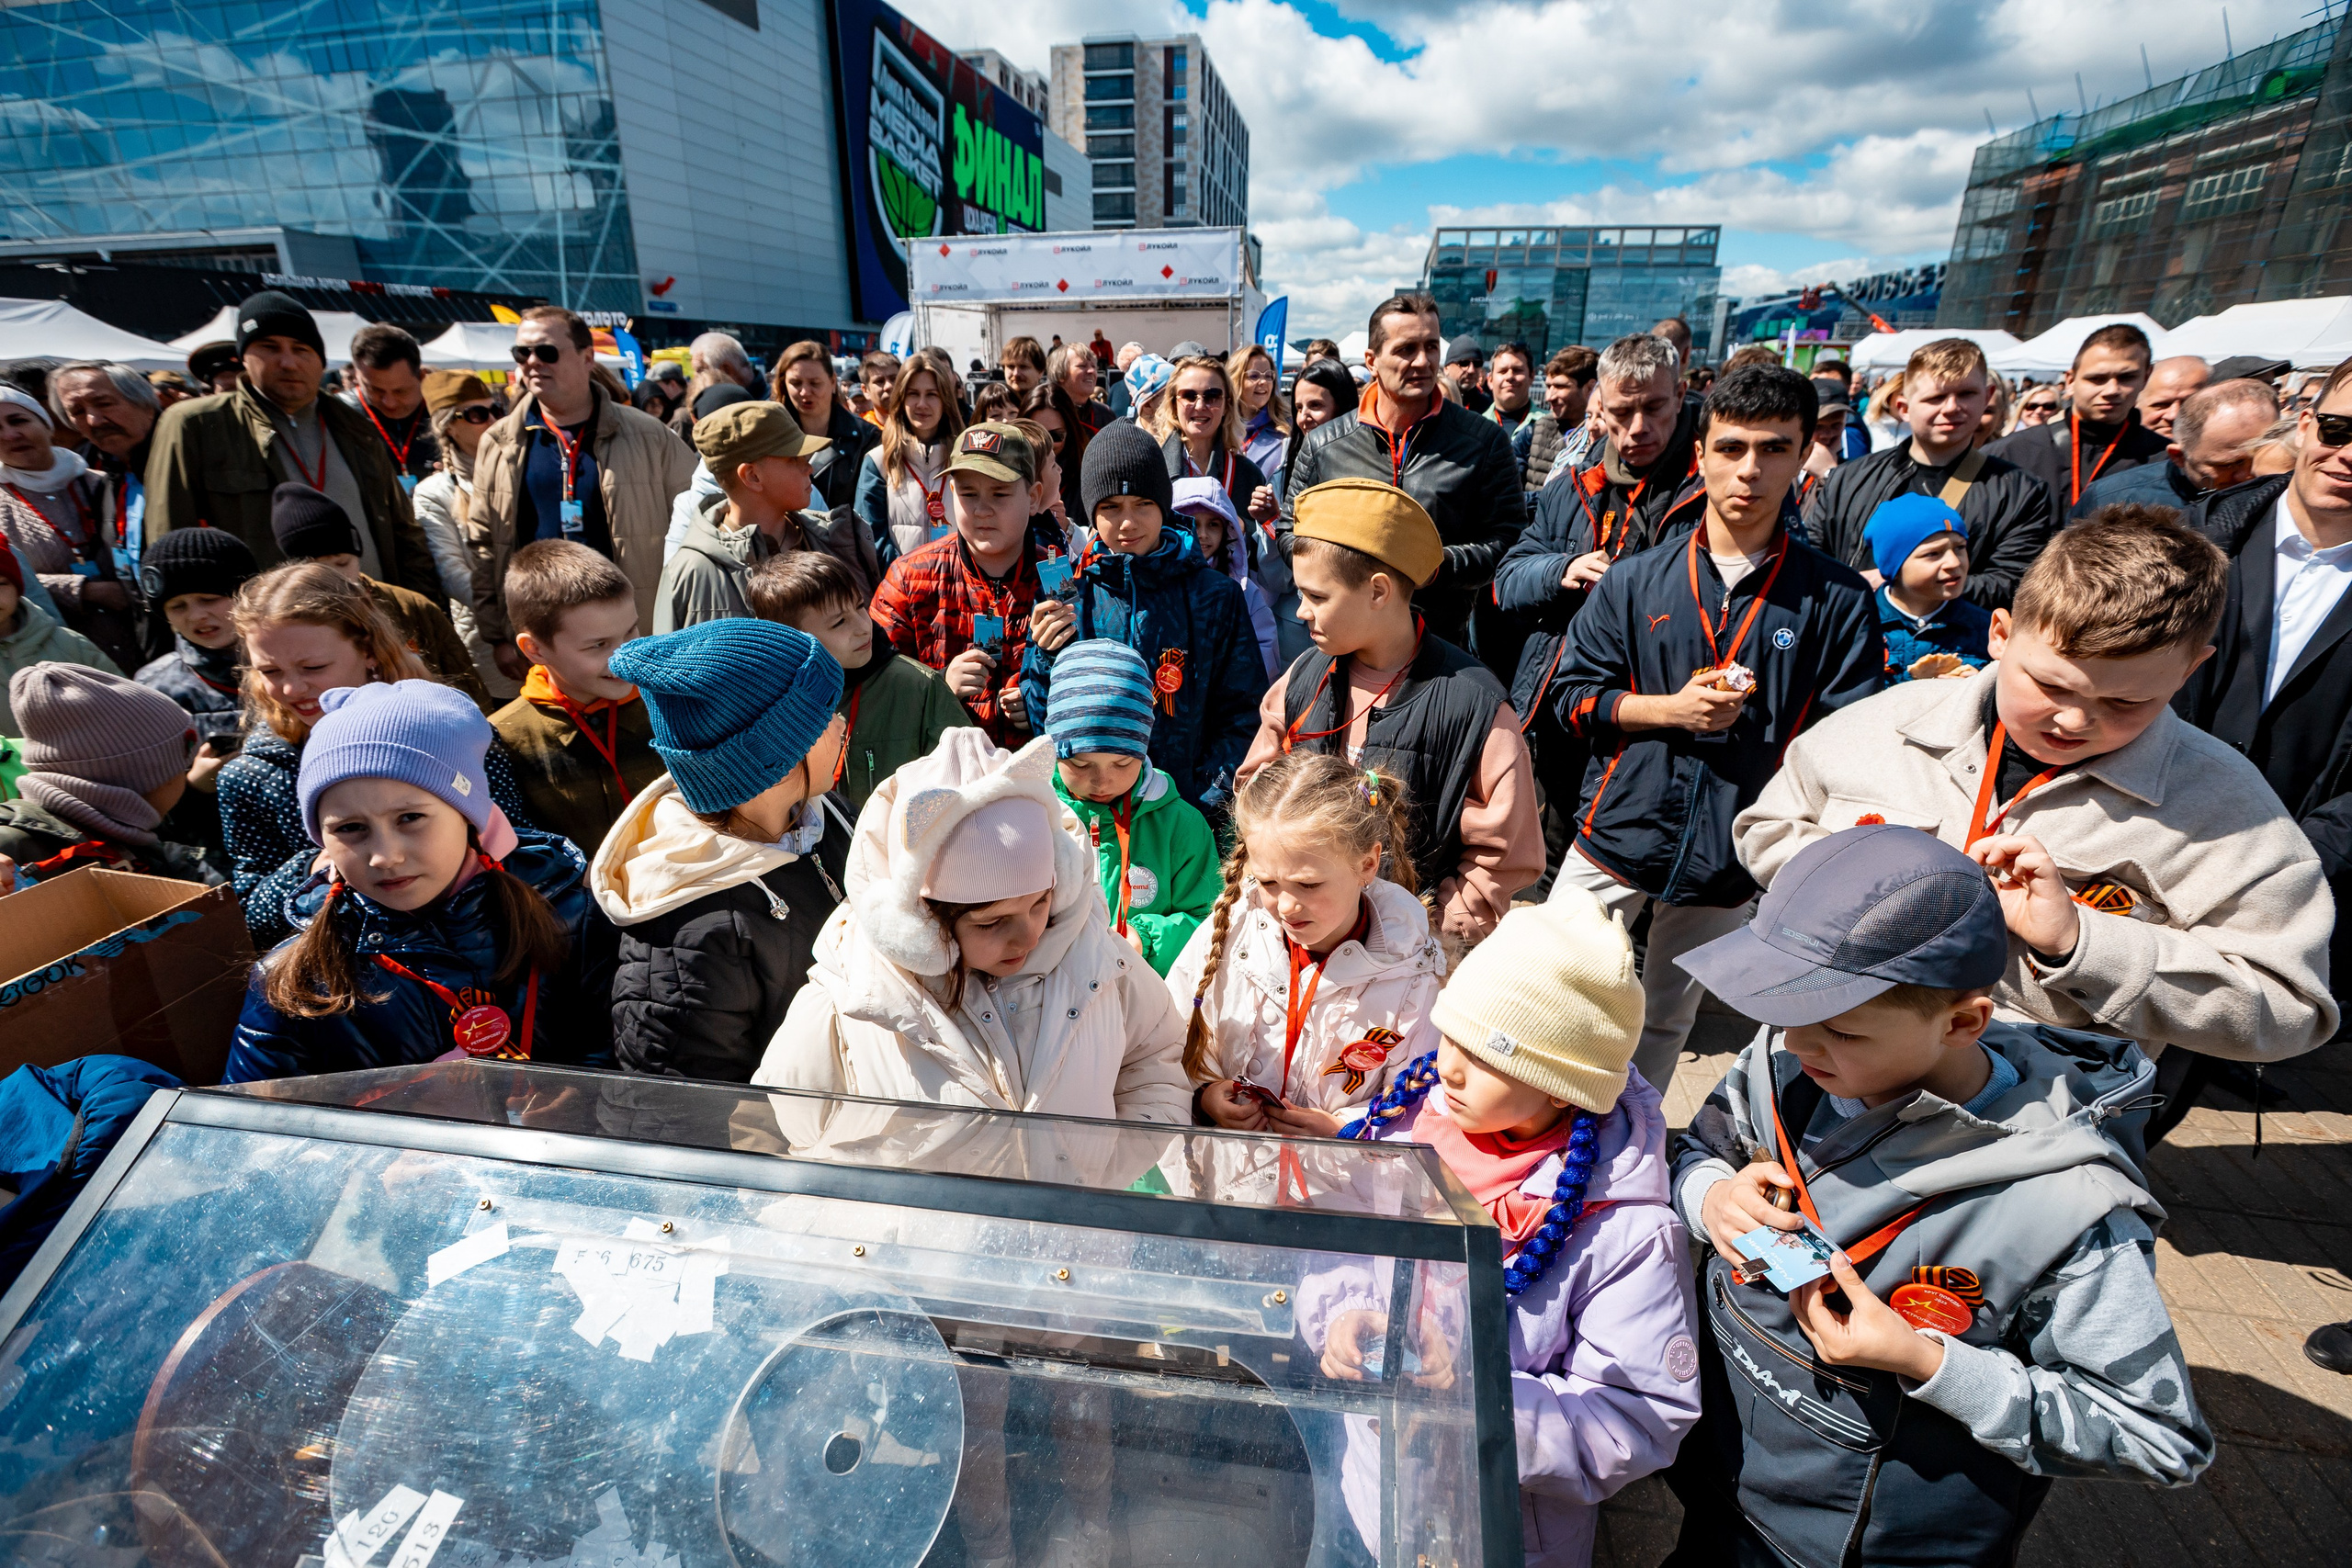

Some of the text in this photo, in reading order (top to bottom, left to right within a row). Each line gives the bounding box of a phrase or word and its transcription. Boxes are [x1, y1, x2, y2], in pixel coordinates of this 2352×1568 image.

[870, 85, 943, 180] MEDIA
[868, 116, 944, 201] BASKET
[953, 102, 1043, 230] ФИНАЛ
[978, 248, 1008, 256] ЛУКОЙЛ
[1060, 244, 1091, 253] ЛУКОЙЛ
[1019, 281, 1049, 289] ЛУКОЙЛ
[1102, 278, 1133, 287] ЛУКОЙЛ
[1188, 276, 1219, 285] ЛУКОЙЛ
[629, 1252, 667, 1272] 675
[1746, 1237, 1794, 1283] УЧАСТНИК
[1902, 1309, 1946, 1330] РЕТРОПРОБЕГ
